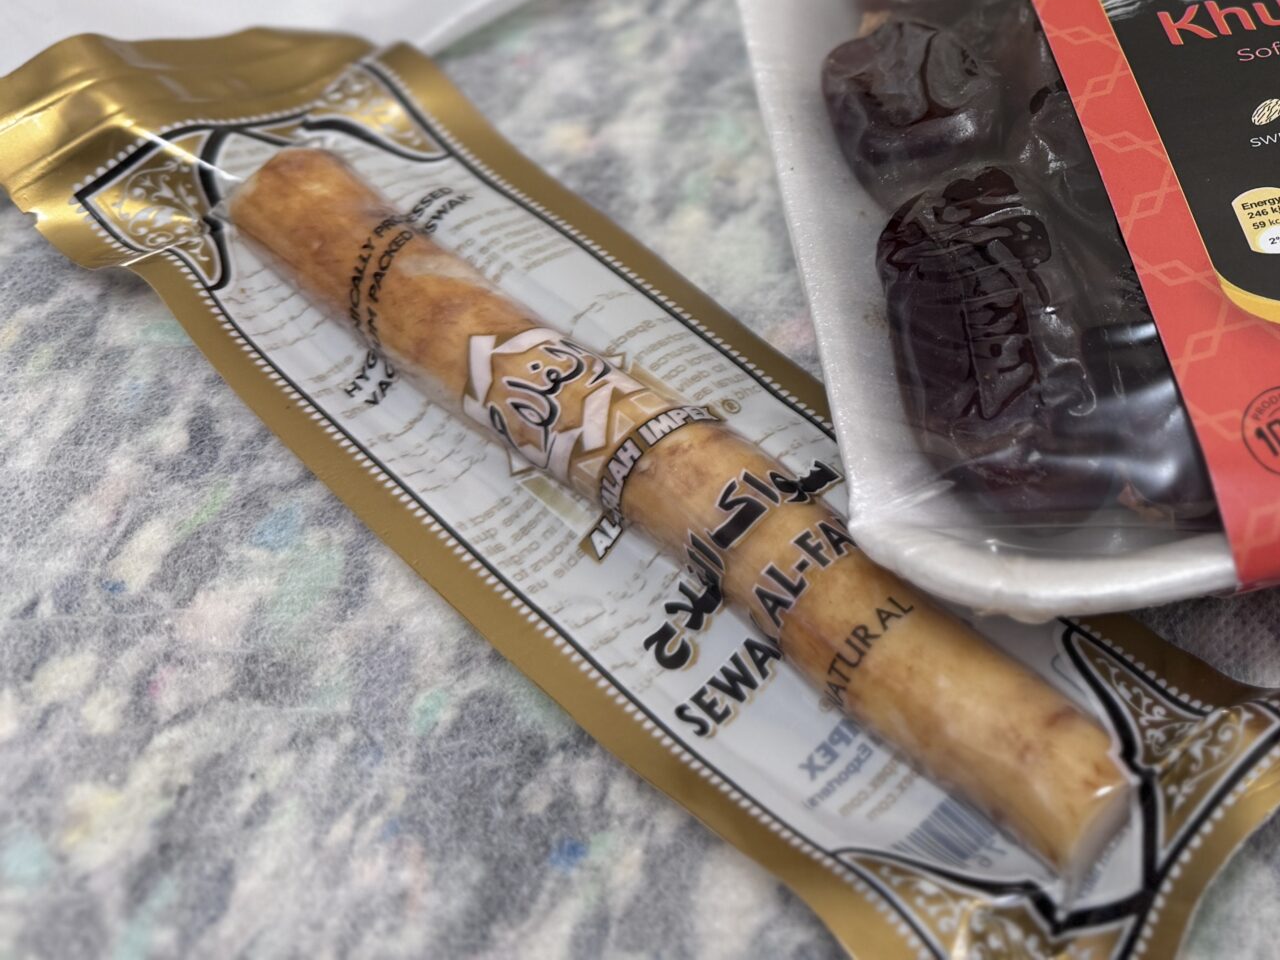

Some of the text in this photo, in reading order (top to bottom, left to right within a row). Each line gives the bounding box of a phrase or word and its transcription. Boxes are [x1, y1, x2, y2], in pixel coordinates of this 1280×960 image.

[1241, 196, 1280, 211] Energy
[1247, 208, 1269, 220] 246
[1252, 221, 1267, 230] 59
[367, 229, 414, 303] PACKED
[754, 515, 857, 629] AL-FA
